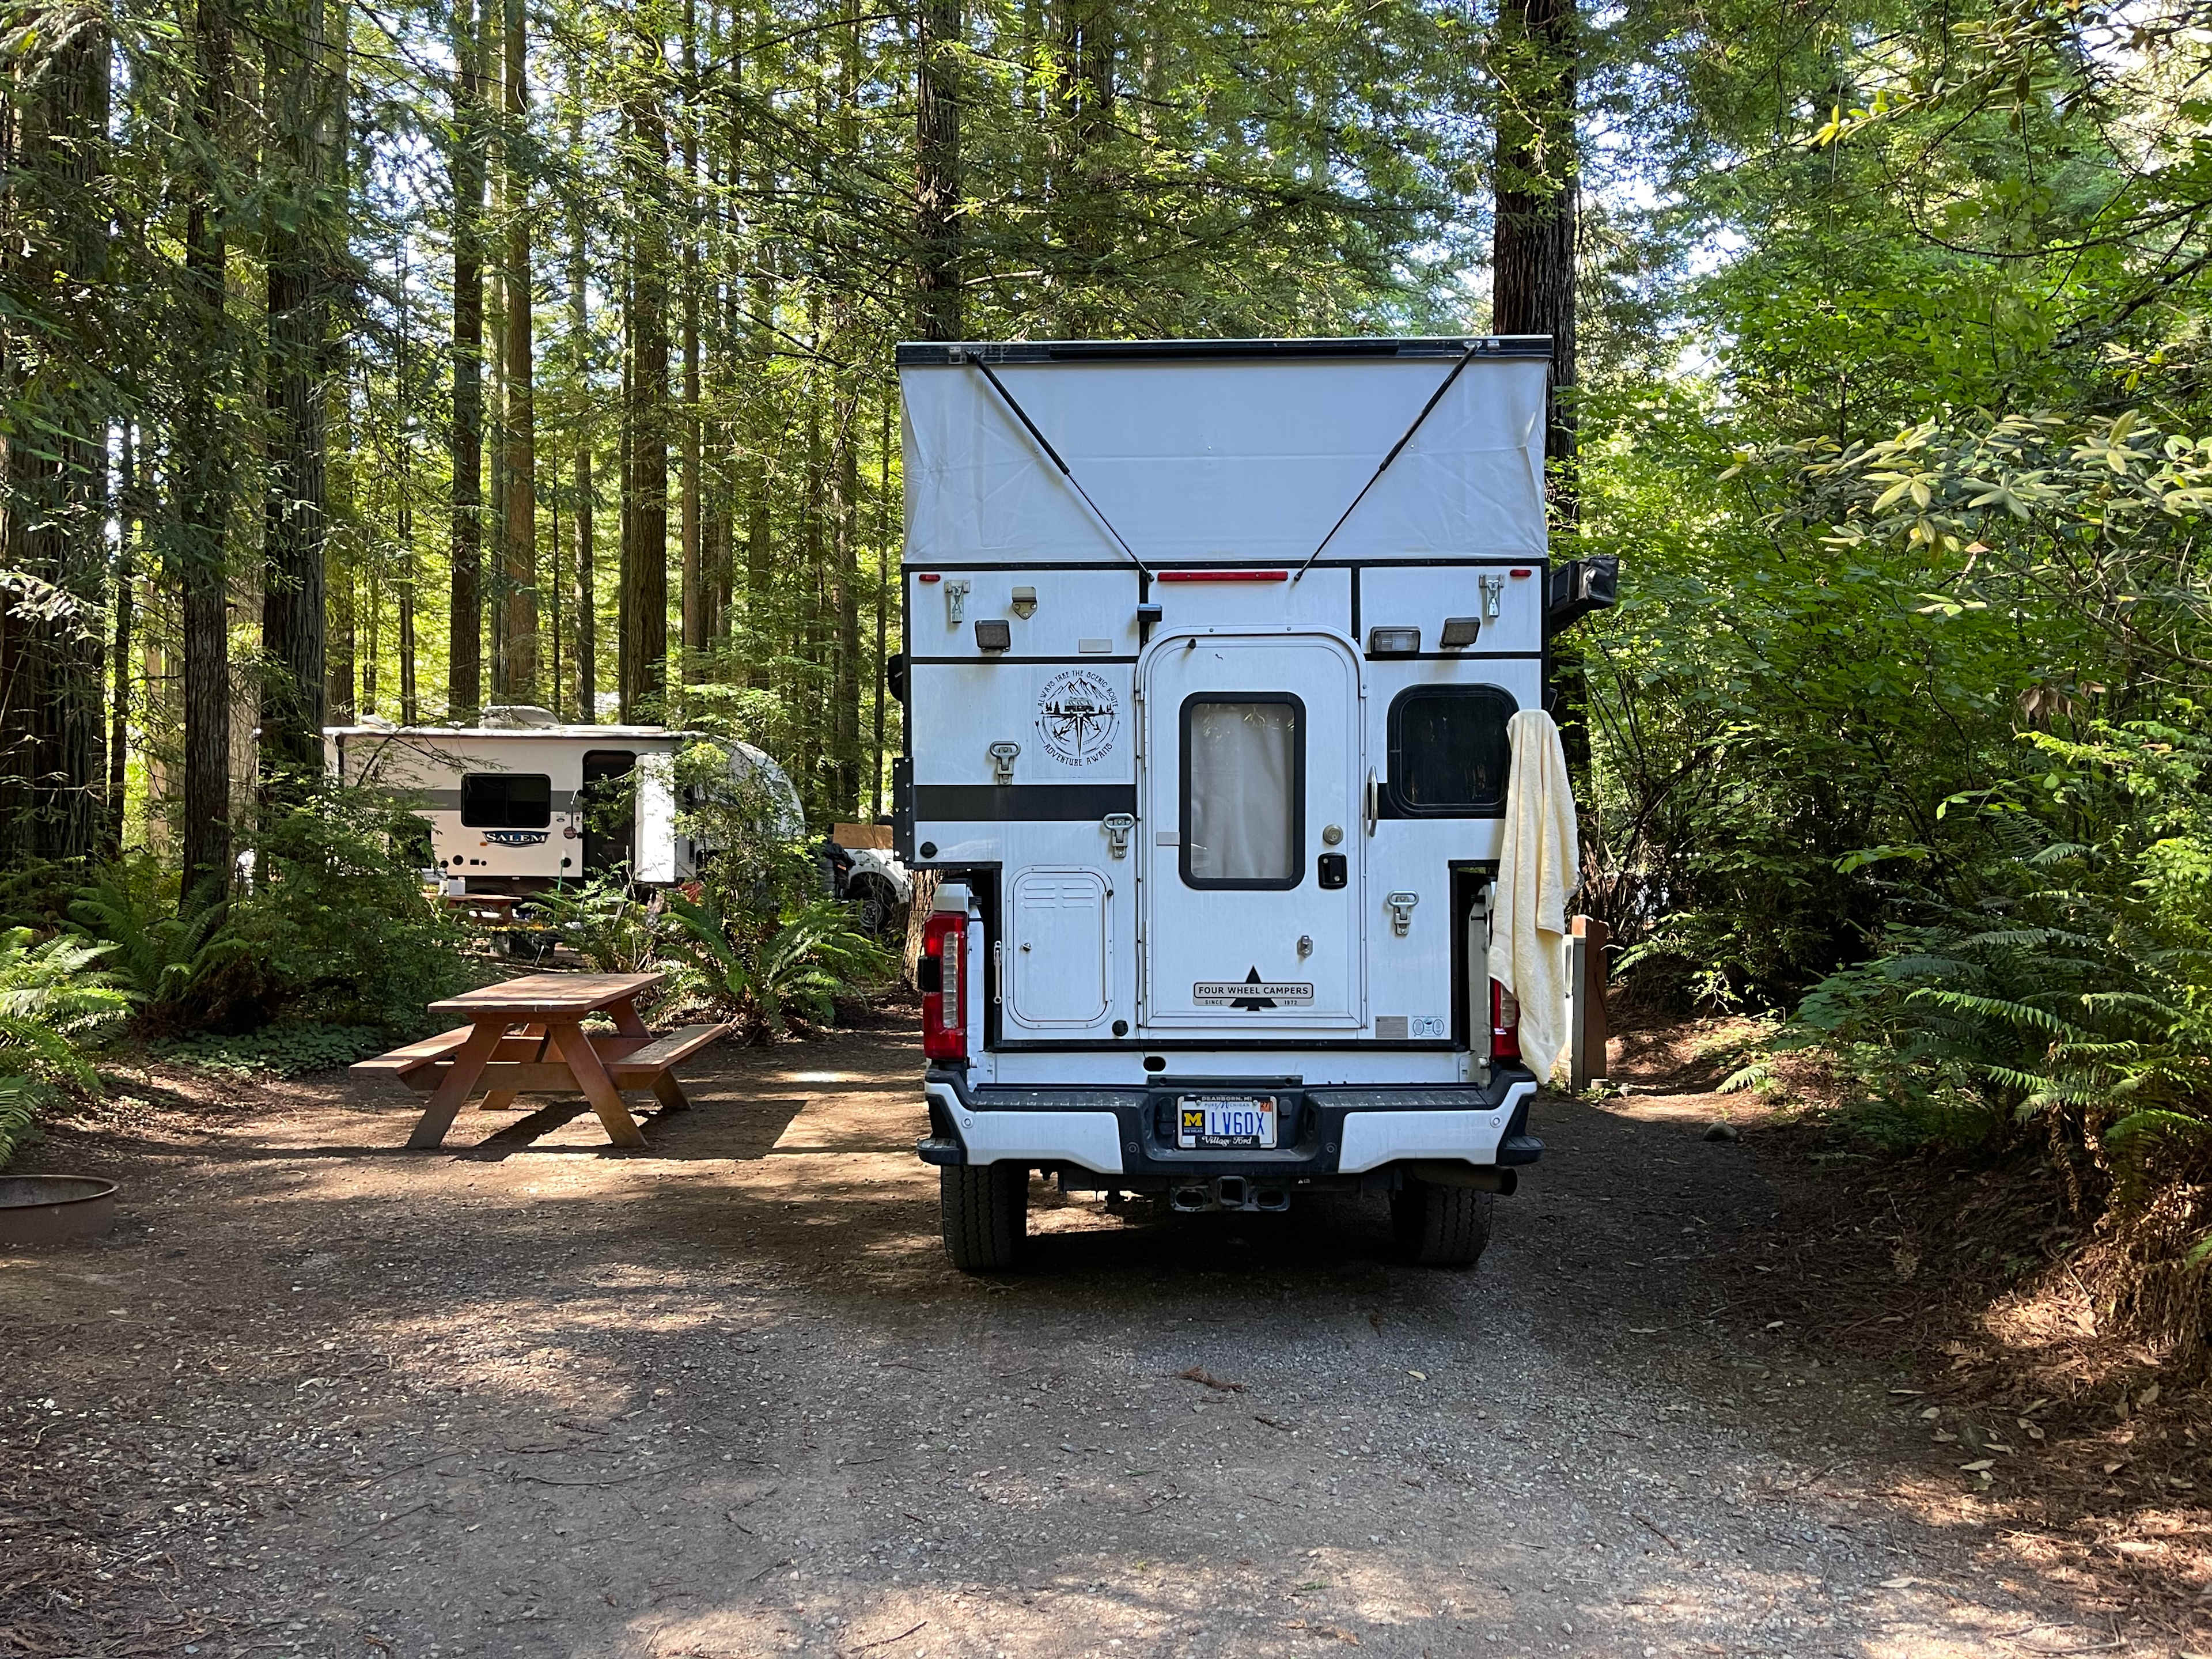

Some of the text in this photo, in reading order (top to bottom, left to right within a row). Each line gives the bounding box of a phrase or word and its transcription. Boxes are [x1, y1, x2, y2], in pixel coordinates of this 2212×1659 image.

[1037, 680, 1055, 707] ALWAYS
[1054, 671, 1070, 683] TAKE
[1086, 671, 1108, 687] SCENIC
[1106, 687, 1119, 708] ROUTE
[1043, 743, 1113, 766] ADVENTURE AWAITS
[486, 832, 546, 842] SALEM
[1215, 1101, 1250, 1109] MICHIGAN
[1184, 1112, 1203, 1127] M
[1232, 1136, 1252, 1145] Ford
